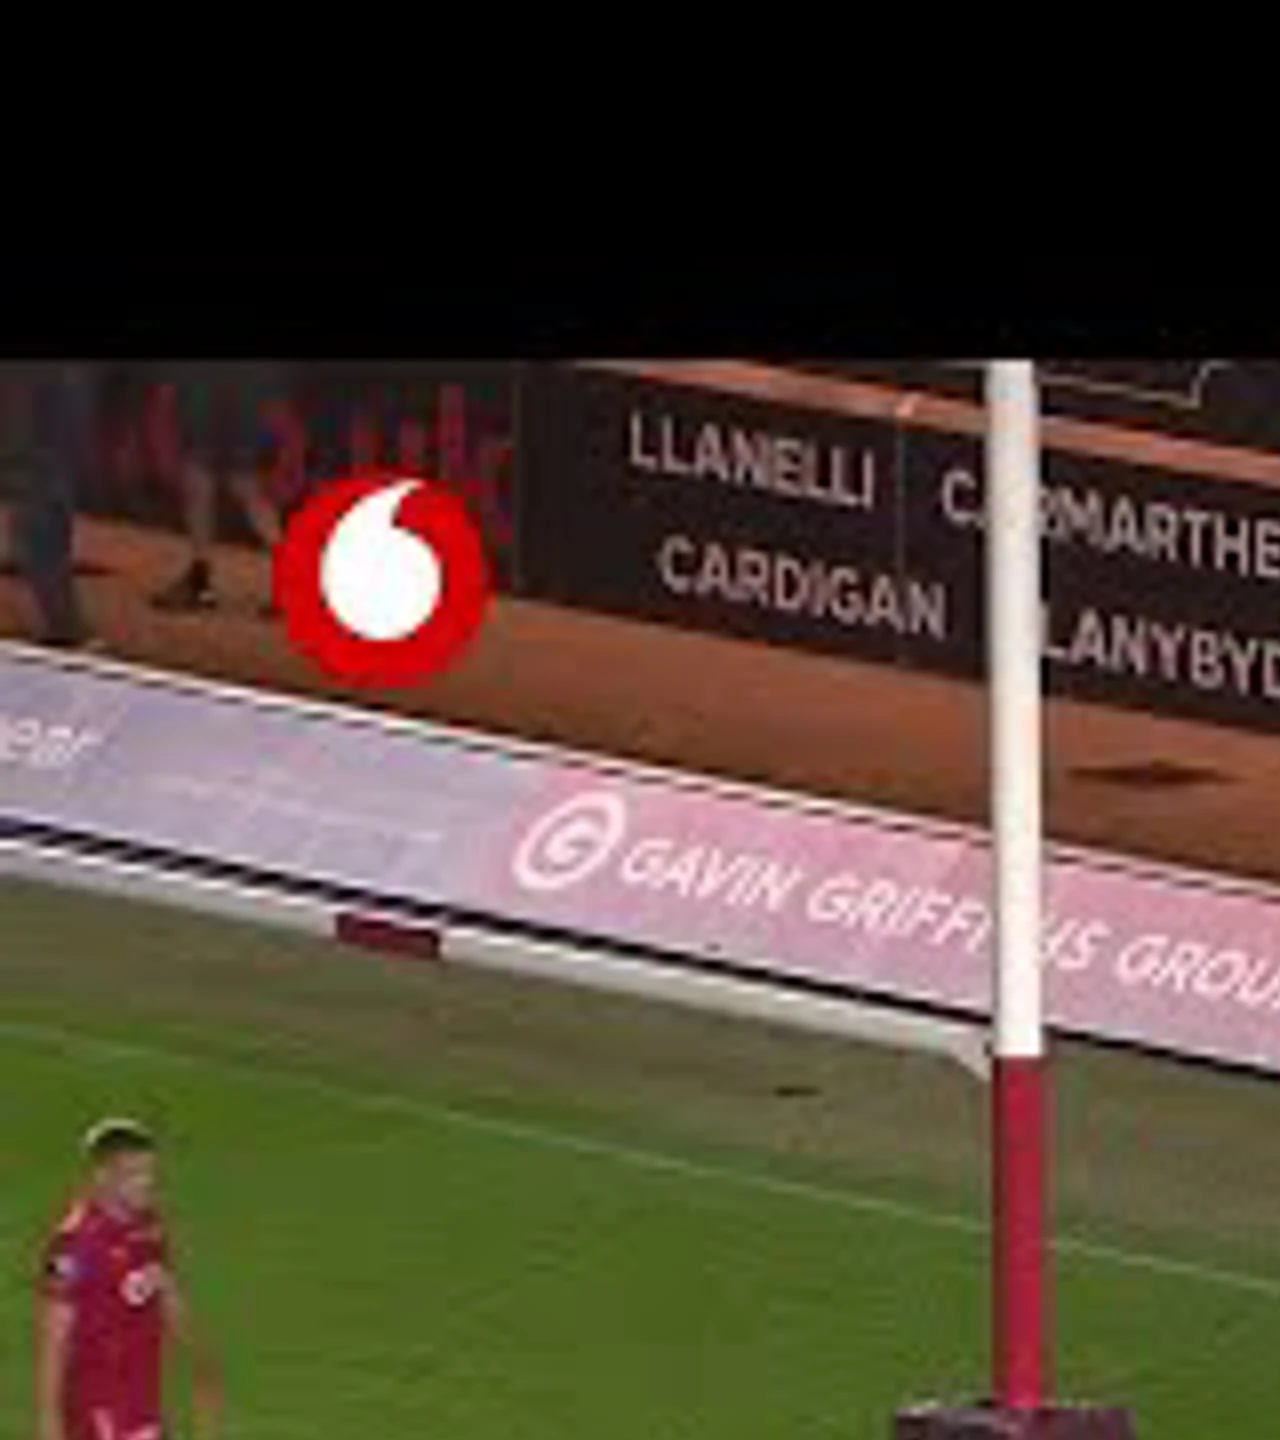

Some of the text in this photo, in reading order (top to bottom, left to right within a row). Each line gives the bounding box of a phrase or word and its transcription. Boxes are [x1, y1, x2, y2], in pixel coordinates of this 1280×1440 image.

[628, 410, 875, 507] LLANELLI
[658, 535, 946, 642] CARDIGAN
[620, 838, 804, 914] GAVIN
